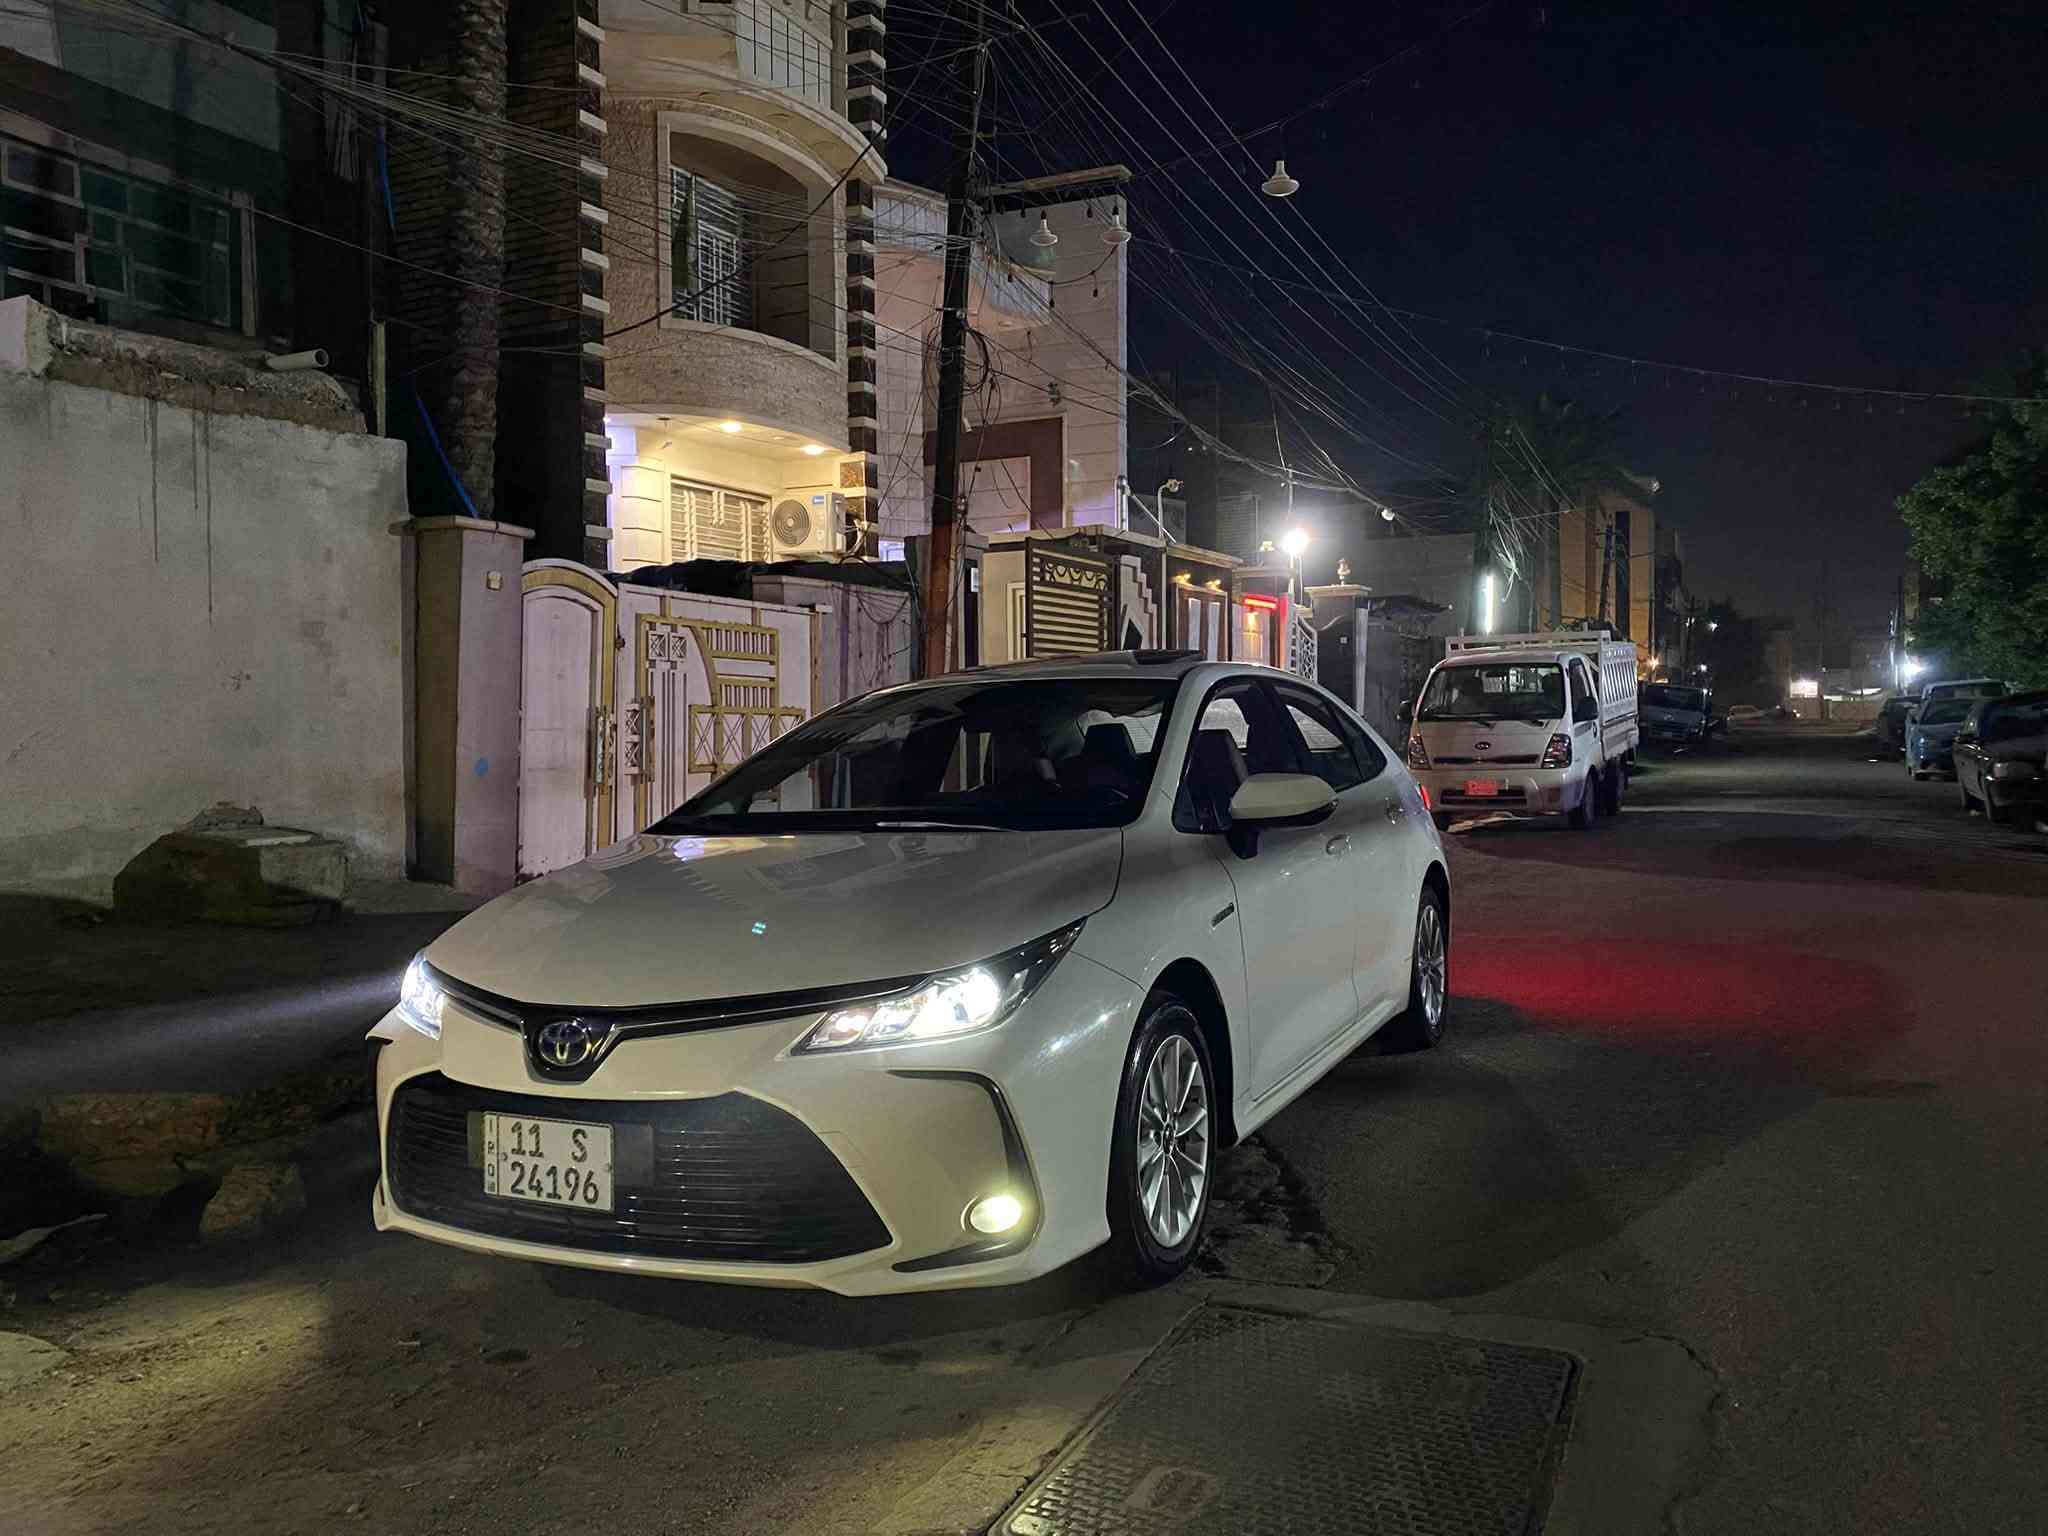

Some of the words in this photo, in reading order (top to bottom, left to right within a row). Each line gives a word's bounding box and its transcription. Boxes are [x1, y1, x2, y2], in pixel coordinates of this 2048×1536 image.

[511, 1121, 544, 1158] 11
[571, 1128, 588, 1163] S
[510, 1161, 600, 1205] 24196
